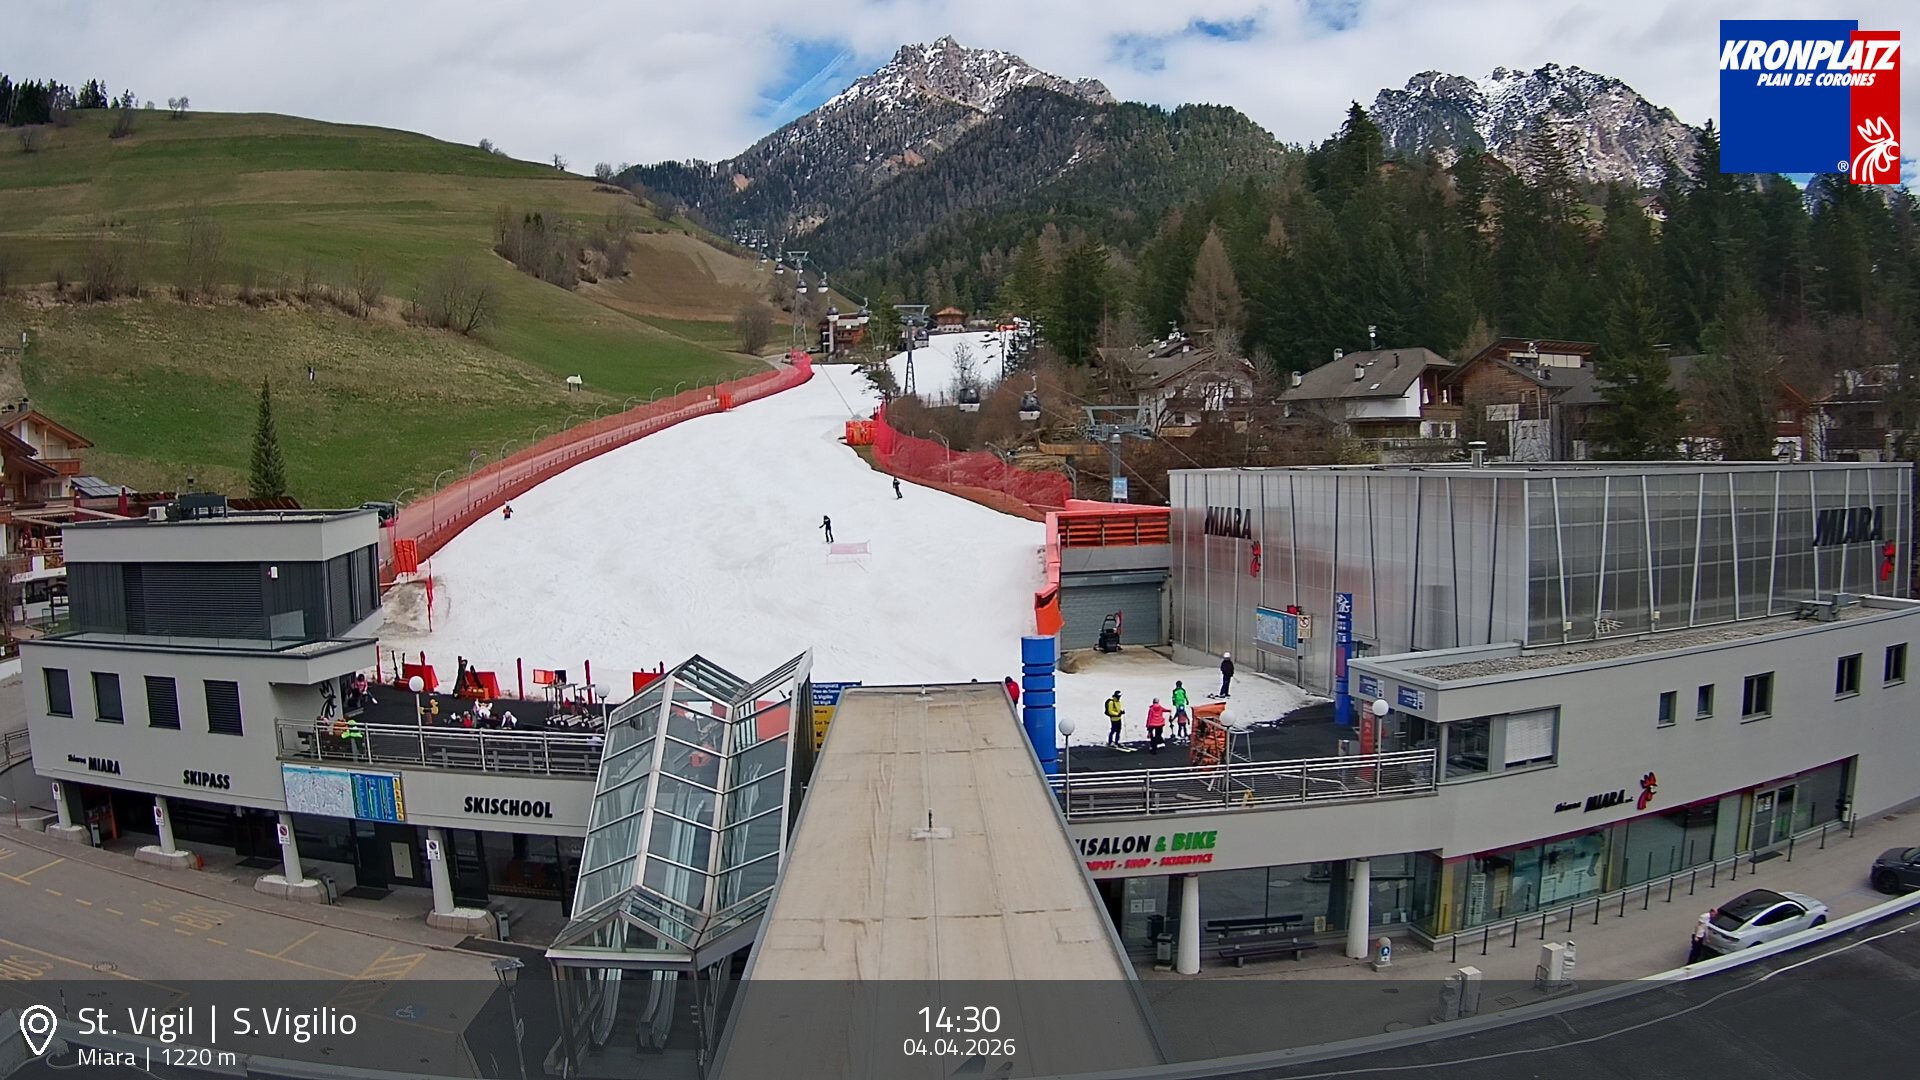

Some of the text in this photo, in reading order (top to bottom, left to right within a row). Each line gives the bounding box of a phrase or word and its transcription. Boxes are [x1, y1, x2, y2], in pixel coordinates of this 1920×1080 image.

[1204, 506, 1252, 540] MIARA
[1813, 506, 1884, 547] MIARA
[88, 756, 121, 776] MIARA
[183, 770, 231, 790] SKIPASS
[464, 796, 553, 818] SKISCHOOL
[1583, 789, 1625, 813] MIARA
[1075, 831, 1217, 856] ISALON & BIKE
[1160, 853, 1213, 866] SKISERVICE
